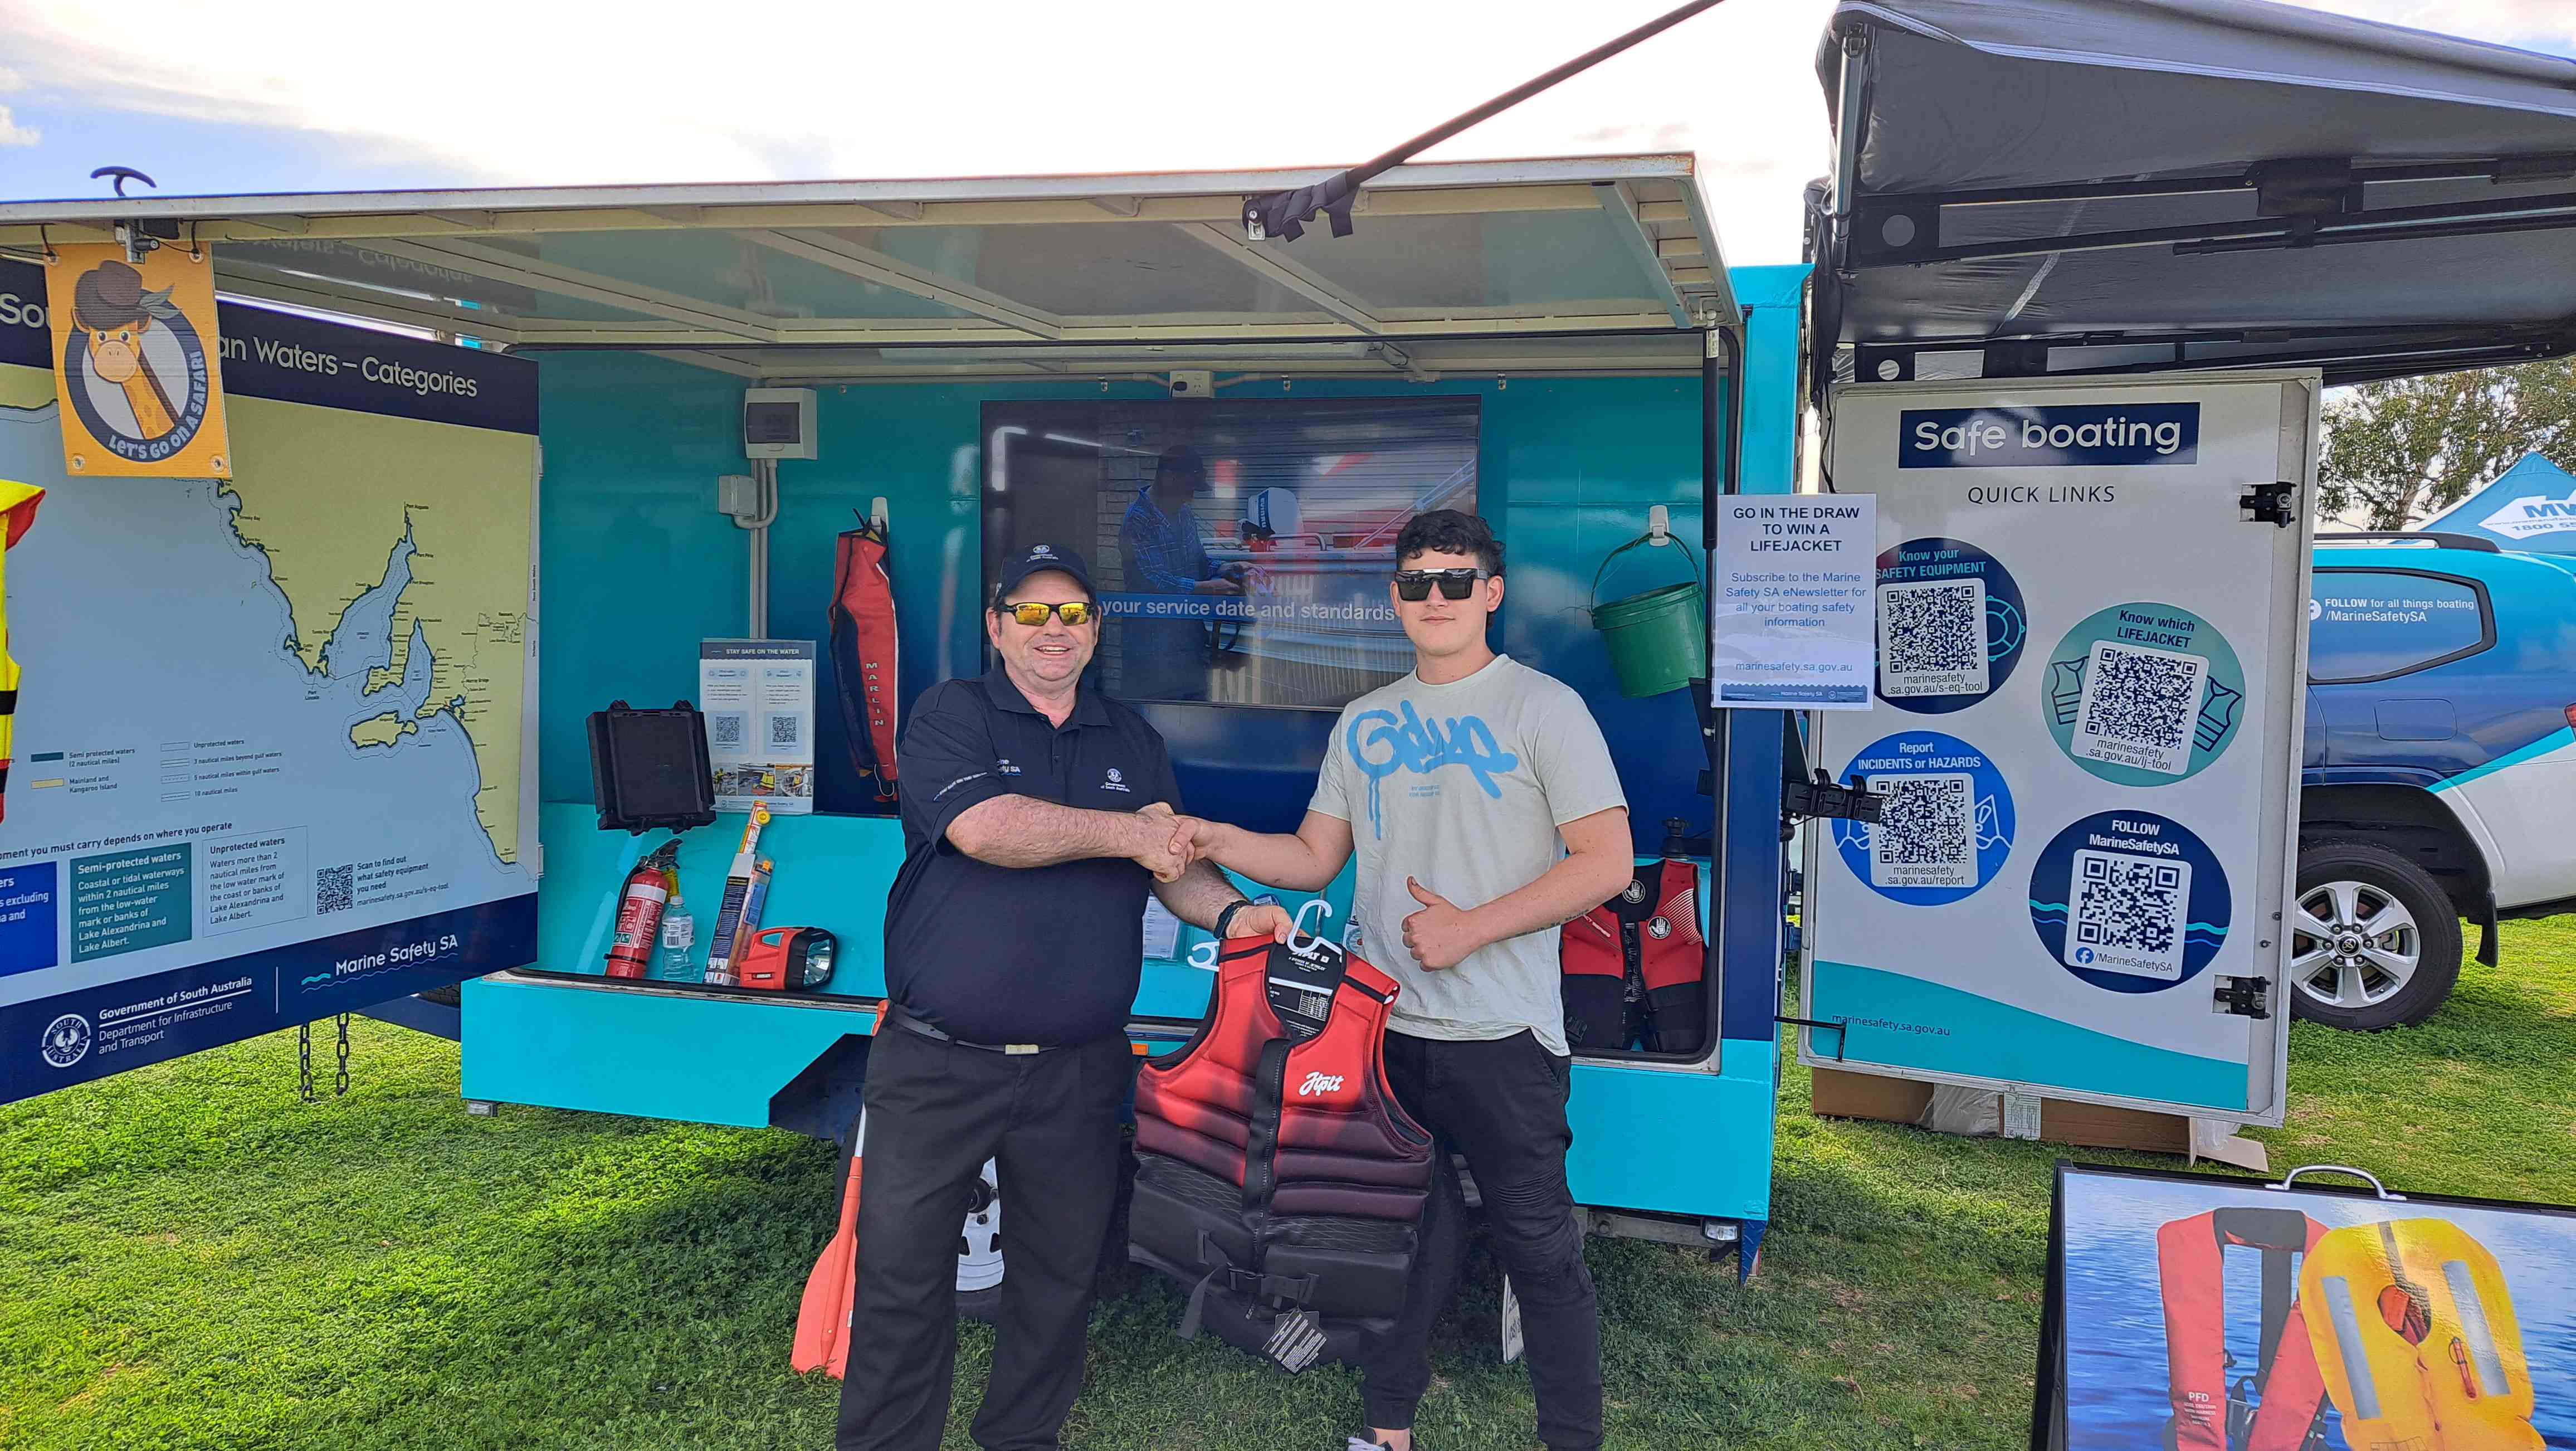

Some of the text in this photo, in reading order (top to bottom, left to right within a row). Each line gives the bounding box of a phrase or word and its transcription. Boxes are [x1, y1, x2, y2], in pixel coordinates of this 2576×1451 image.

[218, 337, 247, 362] an
[252, 336, 338, 376] Waters
[362, 356, 477, 398] Categories
[189, 350, 207, 416] SAFARI
[186, 415, 198, 430] A
[1915, 416, 2181, 456] Safe boating
[149, 440, 170, 459] GO
[1968, 485, 2116, 505] QUICK LINKS
[1733, 507, 1860, 519] GO IN THE DRAW
[1763, 524, 1831, 535] TO WIN A
[2512, 523, 2554, 531] 1800
[1750, 540, 1842, 552] LIFEJACKET
[1899, 549, 1960, 562] Know your
[1731, 572, 1861, 582] Subscribe to the Marine
[1876, 561, 1987, 580] SAFETY EQUIPMENT
[1726, 587, 1866, 598] Safety SA eNewsletter for
[1101, 600, 1395, 621] your service date and standards
[1735, 602, 1855, 614] all your boating safety
[2325, 598, 2475, 610] FOLLOW for all things boating
[1764, 617, 1825, 627] information
[2119, 610, 2195, 632] Know which
[2326, 611, 2427, 624] /MarineSafetySA
[2117, 626, 2192, 648] LIFEJACKET
[1735, 662, 1853, 673] marinesafety.sa.gov.au
[1904, 673, 1965, 684] marinesafety
[1888, 681, 1983, 695] .sa.gov.au/s-eq-tool
[194, 740, 226, 748] Unprotected
[1899, 742, 1934, 754] Report
[2096, 739, 2164, 760] marinesafety
[86, 749, 114, 758] protected
[2086, 748, 2172, 771] .sa.gov.au/lj-tool
[1858, 757, 1981, 770] INCIDENTS or HAZARDS
[2111, 820, 2160, 836] FOLLOW
[31, 846, 48, 858] you
[51, 843, 75, 854] must
[77, 839, 102, 850] carry
[104, 834, 142, 846] depends
[156, 829, 183, 839] where
[185, 826, 199, 837] you
[201, 822, 232, 834] operate
[210, 838, 285, 855] Unprotected waters
[2089, 834, 2179, 855] MarineSafetySA
[77, 851, 182, 875] Semi-protected waters
[210, 859, 238, 869] Waters
[237, 856, 256, 864] more
[257, 853, 272, 861] than
[382, 857, 394, 866] find
[396, 855, 407, 864] out
[78, 866, 185, 890] Coastal or tidal waterways
[210, 863, 276, 880] nautical miles from
[357, 863, 429, 882] what safety equipment
[1894, 865, 1955, 877] marinesafety
[357, 881, 387, 895] you need
[1885, 875, 1965, 887] .sa.gov.au/report
[6, 891, 49, 907] excluding
[78, 880, 169, 903] within 2 nautical miles
[78, 895, 158, 916] from the low-water
[9, 908, 26, 921] and
[79, 907, 149, 929] mark or banks of
[79, 916, 167, 941] Lake Alexandrina and
[79, 936, 130, 953] Lake Albert.
[336, 934, 458, 976] Marine Safety SA
[2095, 952, 2173, 972] /MarineSafetySA
[99, 976, 252, 1020] Government of South Australia
[51, 1017, 83, 1035] SOUTH
[99, 1001, 232, 1042] Department for Infrastructure
[1832, 1014, 1950, 1036] marinesafety.sa.gov.au
[99, 1029, 165, 1055] and Transport
[2188, 1391, 2209, 1402] PFD
